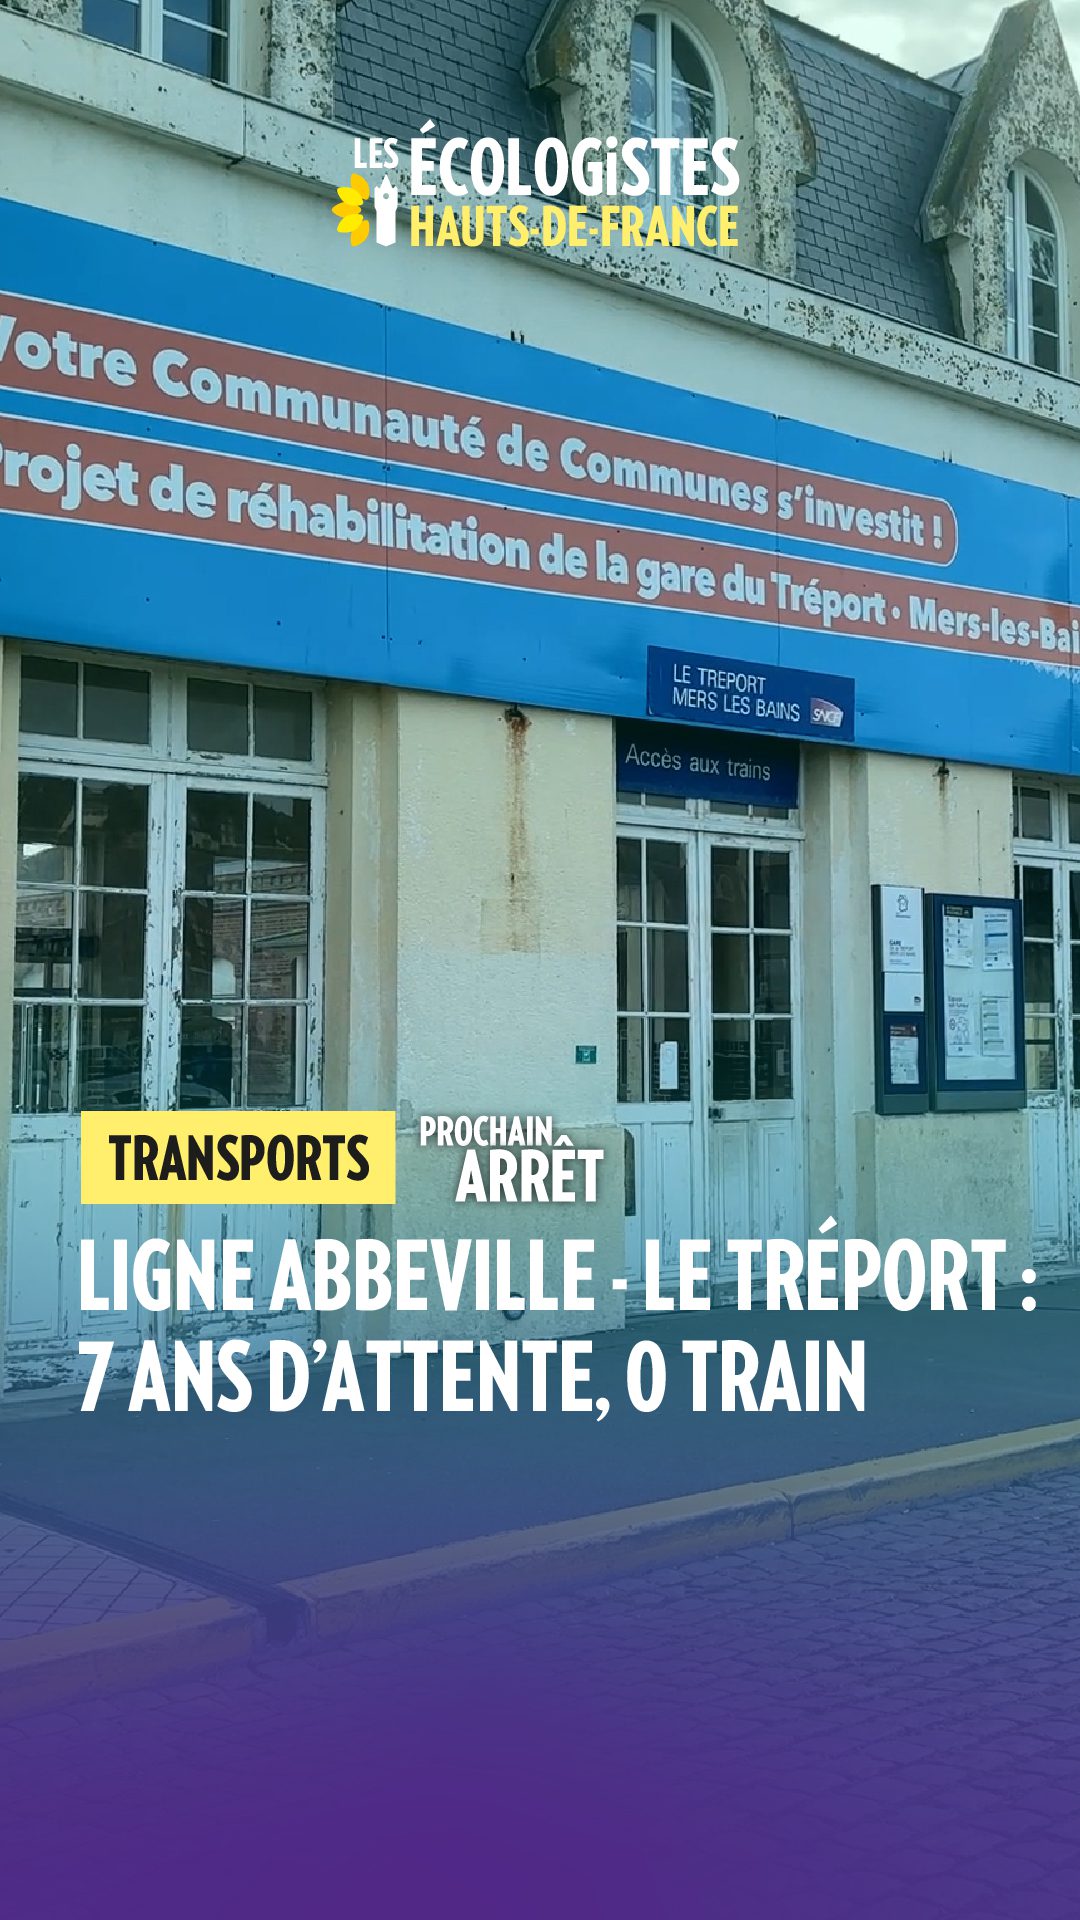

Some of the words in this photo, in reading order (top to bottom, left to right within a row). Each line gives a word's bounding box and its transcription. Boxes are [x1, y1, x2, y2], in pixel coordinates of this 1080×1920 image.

[152, 349, 486, 458] Communauté
[497, 423, 548, 472] de
[560, 438, 769, 515] Communes
[933, 515, 943, 549] !
[0, 442, 139, 511] rojet
[150, 463, 216, 518] de
[227, 482, 530, 571] réhabilitation
[539, 532, 587, 578] de
[596, 540, 628, 585] la
[636, 557, 715, 599] gare
[723, 563, 765, 605] du
[771, 571, 886, 627] Tréport
[673, 663, 691, 684] LE
[698, 667, 766, 695] TREPORT
[673, 687, 718, 711] MERS
[723, 694, 750, 715] LES
[755, 700, 801, 722] BAINS
[625, 742, 682, 771] Accès
[690, 756, 720, 775] aux
[727, 757, 771, 781] trains
